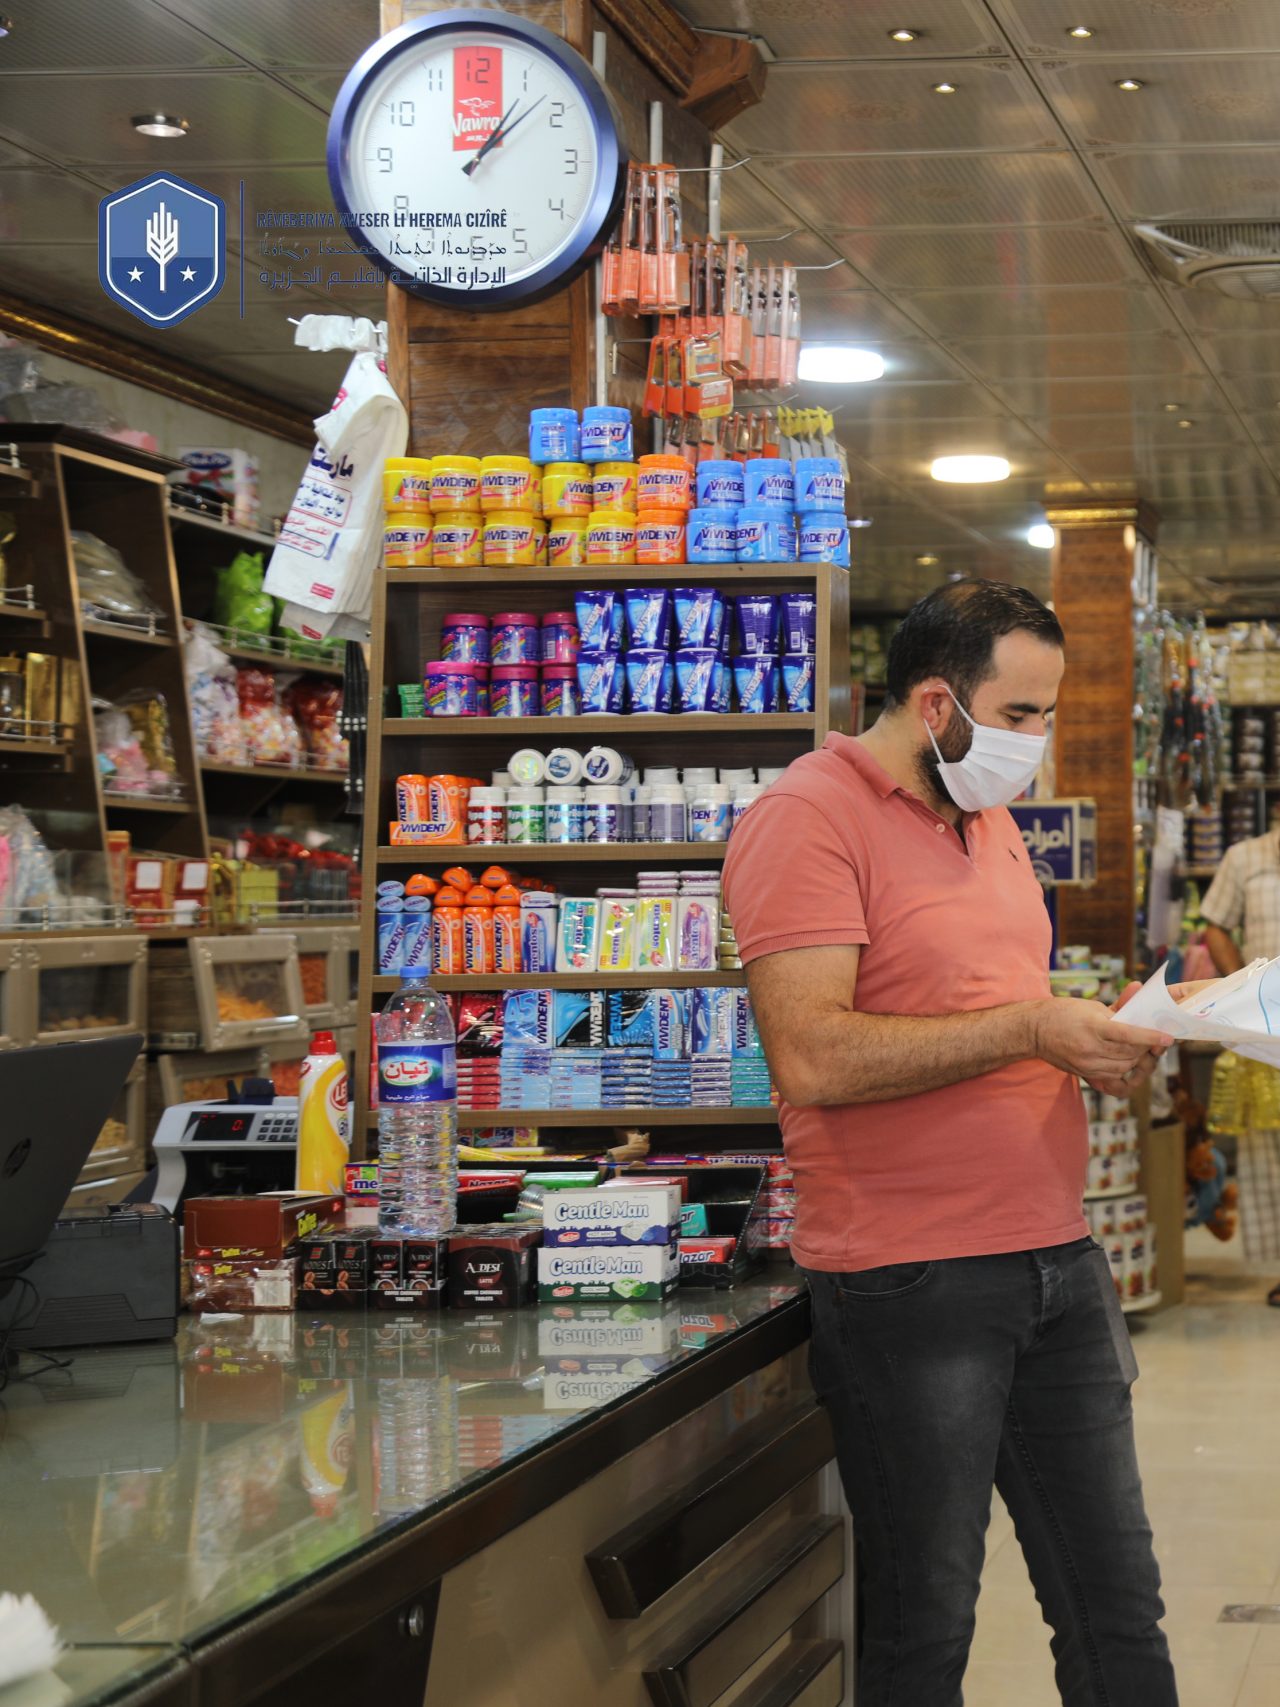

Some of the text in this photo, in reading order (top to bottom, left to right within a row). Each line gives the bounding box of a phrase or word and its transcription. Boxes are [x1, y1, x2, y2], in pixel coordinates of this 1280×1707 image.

[428, 68, 443, 92] 11
[466, 57, 491, 84] 12
[522, 69, 528, 92] 1
[390, 101, 415, 127] 10
[549, 102, 565, 128] 2
[377, 147, 393, 173] 9
[564, 149, 578, 174] 3
[548, 198, 564, 221] 4
[512, 228, 528, 253] 5
[400, 823, 447, 833] VIVIDENT
[575, 903, 584, 946] mento
[659, 995, 670, 1051] VIVIDENT
